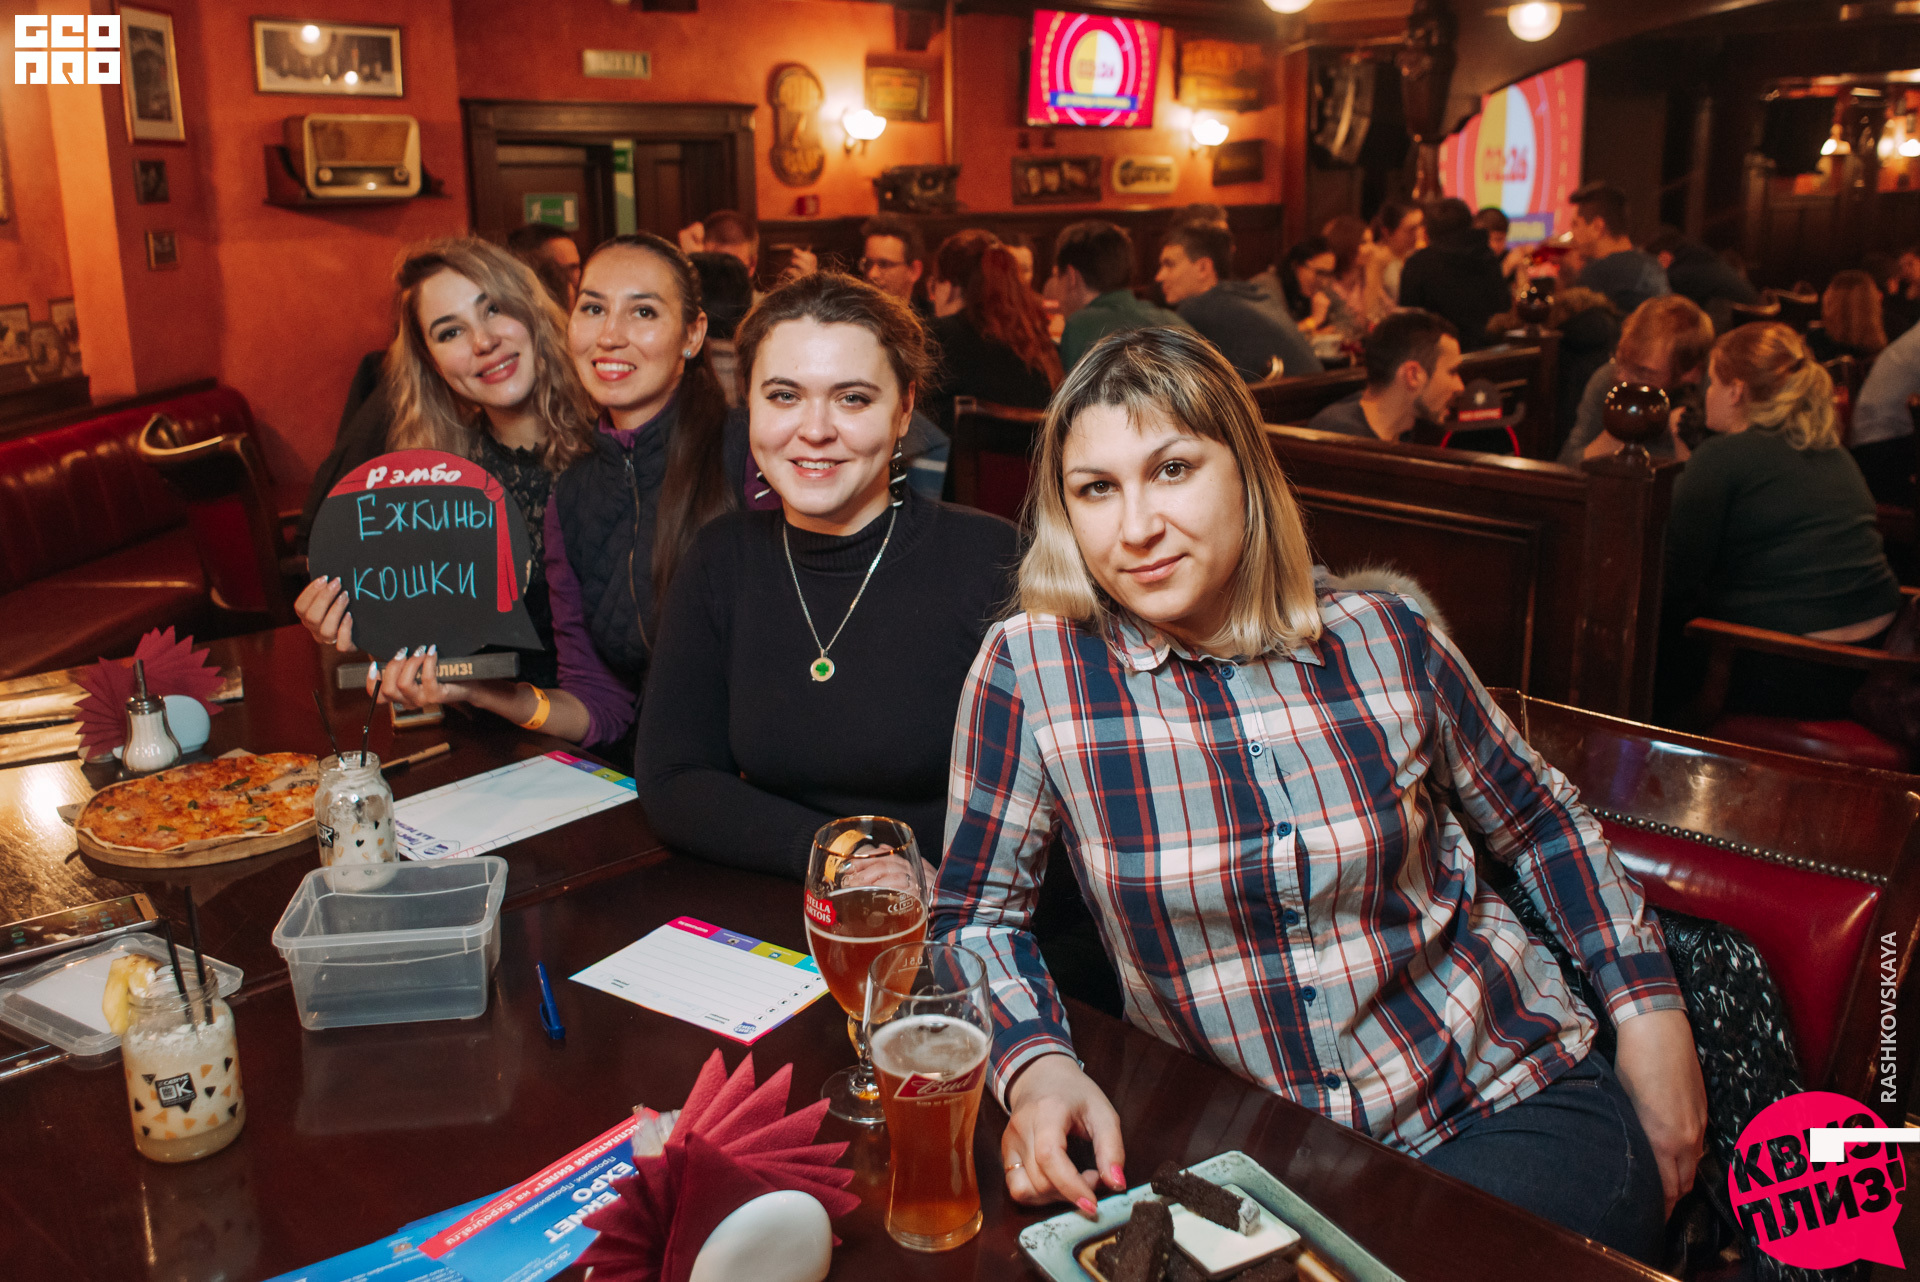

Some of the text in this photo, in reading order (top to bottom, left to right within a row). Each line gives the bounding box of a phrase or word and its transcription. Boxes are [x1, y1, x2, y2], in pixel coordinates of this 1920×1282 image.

[436, 662, 473, 677] ЛИЗ!
[806, 894, 831, 914] STELLA
[806, 903, 831, 923] ARTOIS
[911, 1071, 973, 1096] Bud
[575, 1122, 641, 1169] ЕСПЛАТНЫЙ
[572, 1159, 634, 1204] EXPO
